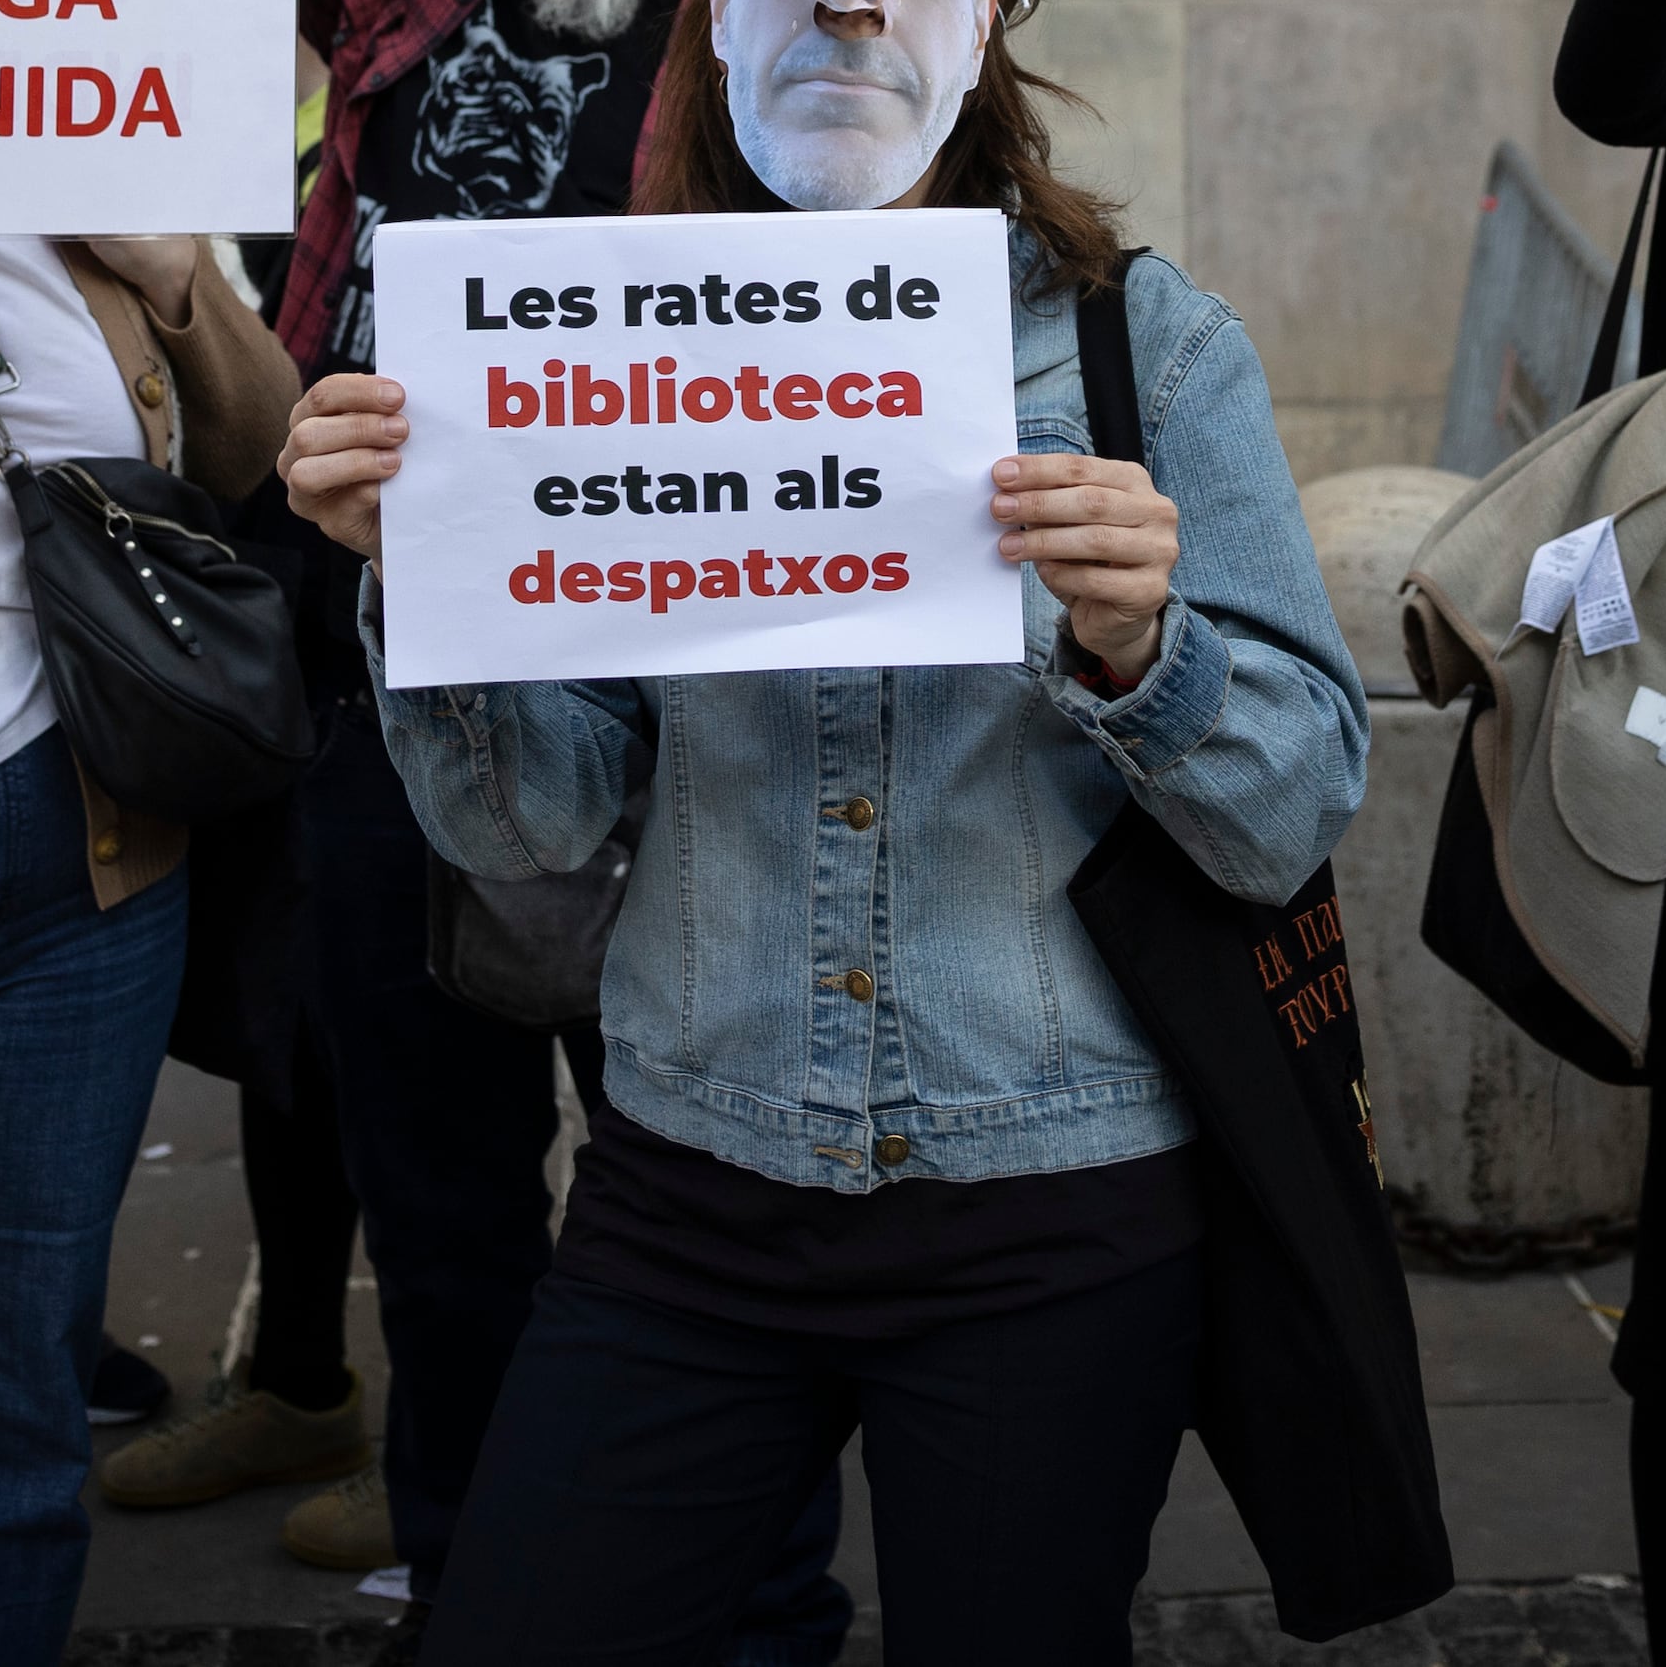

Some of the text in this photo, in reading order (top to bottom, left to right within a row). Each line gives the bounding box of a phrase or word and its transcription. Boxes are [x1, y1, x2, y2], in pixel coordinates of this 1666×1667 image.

[466, 265, 940, 330] Les rates de
[488, 357, 922, 428] biblioteca
[534, 455, 882, 516] estan als
[509, 550, 909, 614] despatxos
